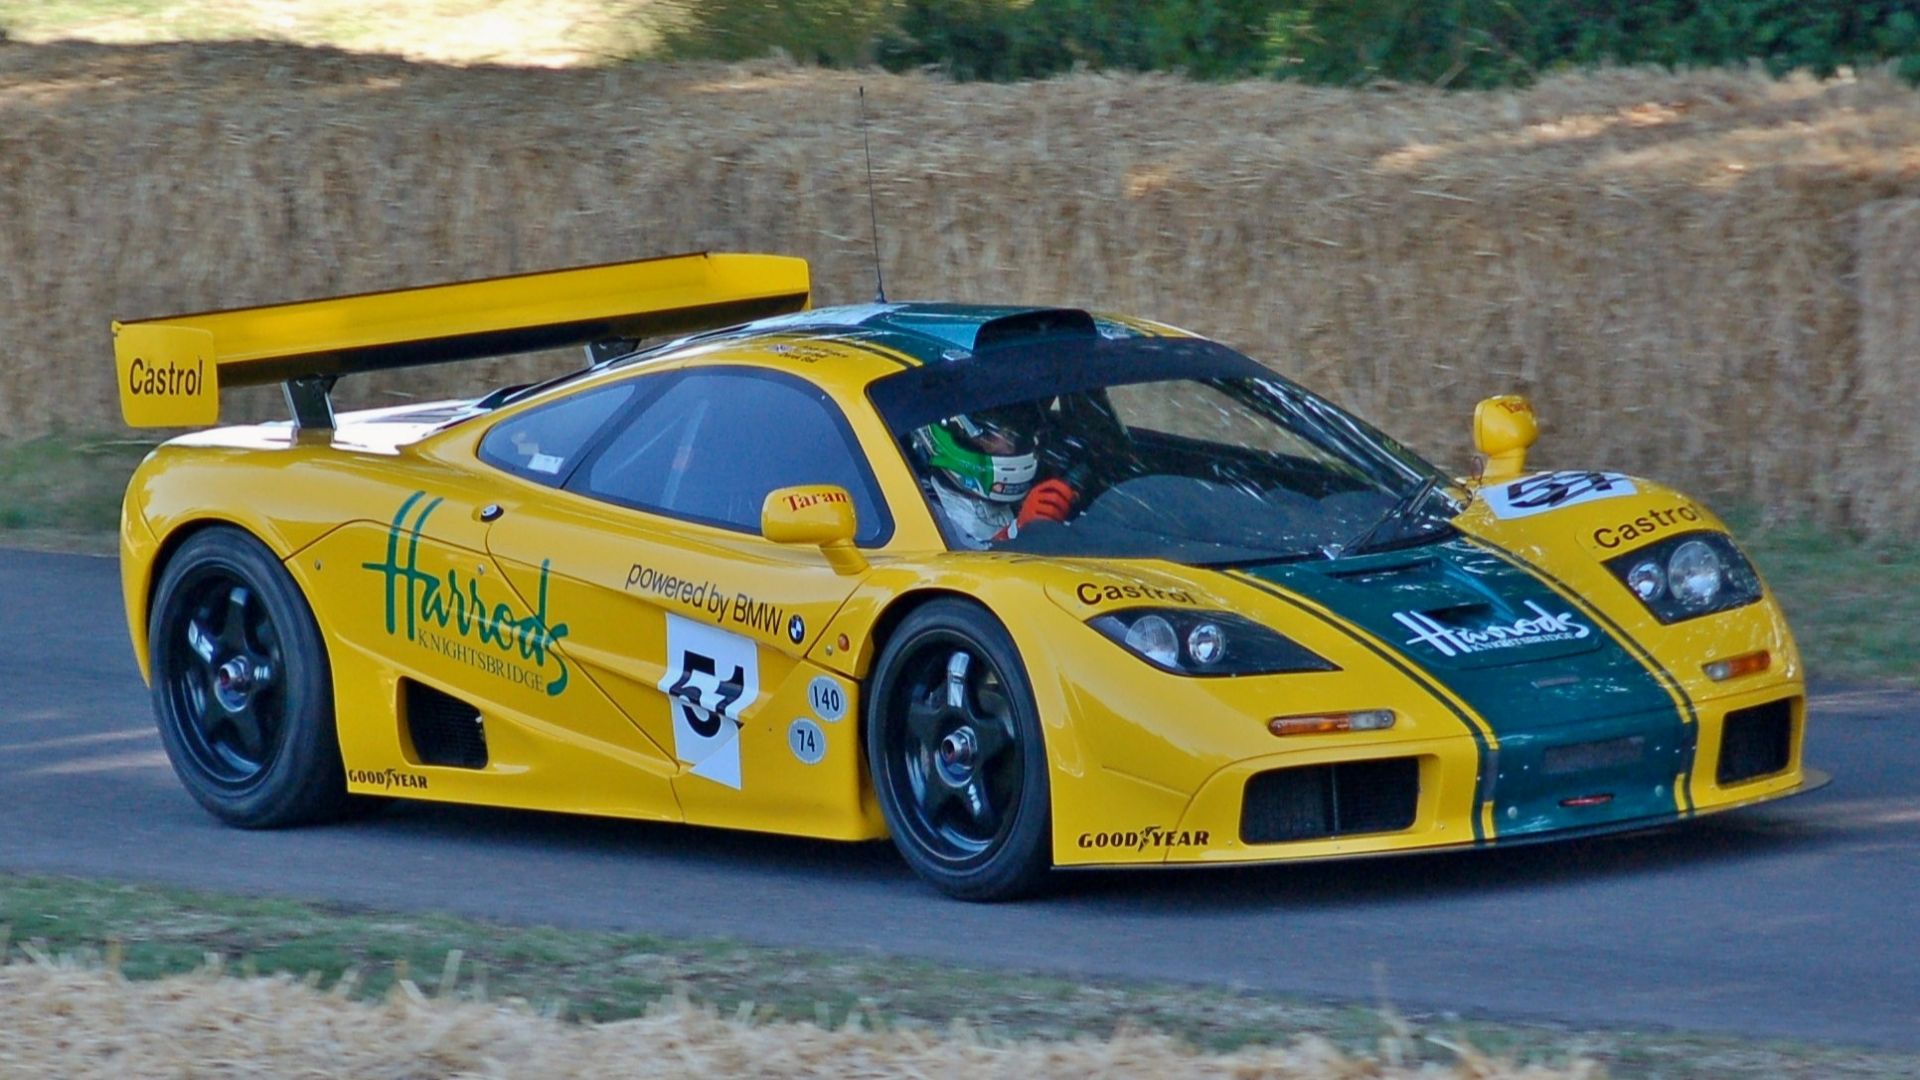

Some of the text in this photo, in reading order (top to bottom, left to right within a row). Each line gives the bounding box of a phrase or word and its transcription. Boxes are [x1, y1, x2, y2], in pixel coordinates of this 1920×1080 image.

[128, 357, 204, 396] Castrol
[782, 491, 848, 513] Taran
[361, 489, 569, 697] Harrods
[624, 563, 783, 636] powered by BMW
[1076, 582, 1198, 606] Castrol
[1391, 599, 1590, 657] Harrods
[417, 628, 545, 694] KNIGHTSBRIDGE
[668, 649, 745, 738] 51
[813, 685, 840, 712] 140
[796, 728, 816, 753] 74
